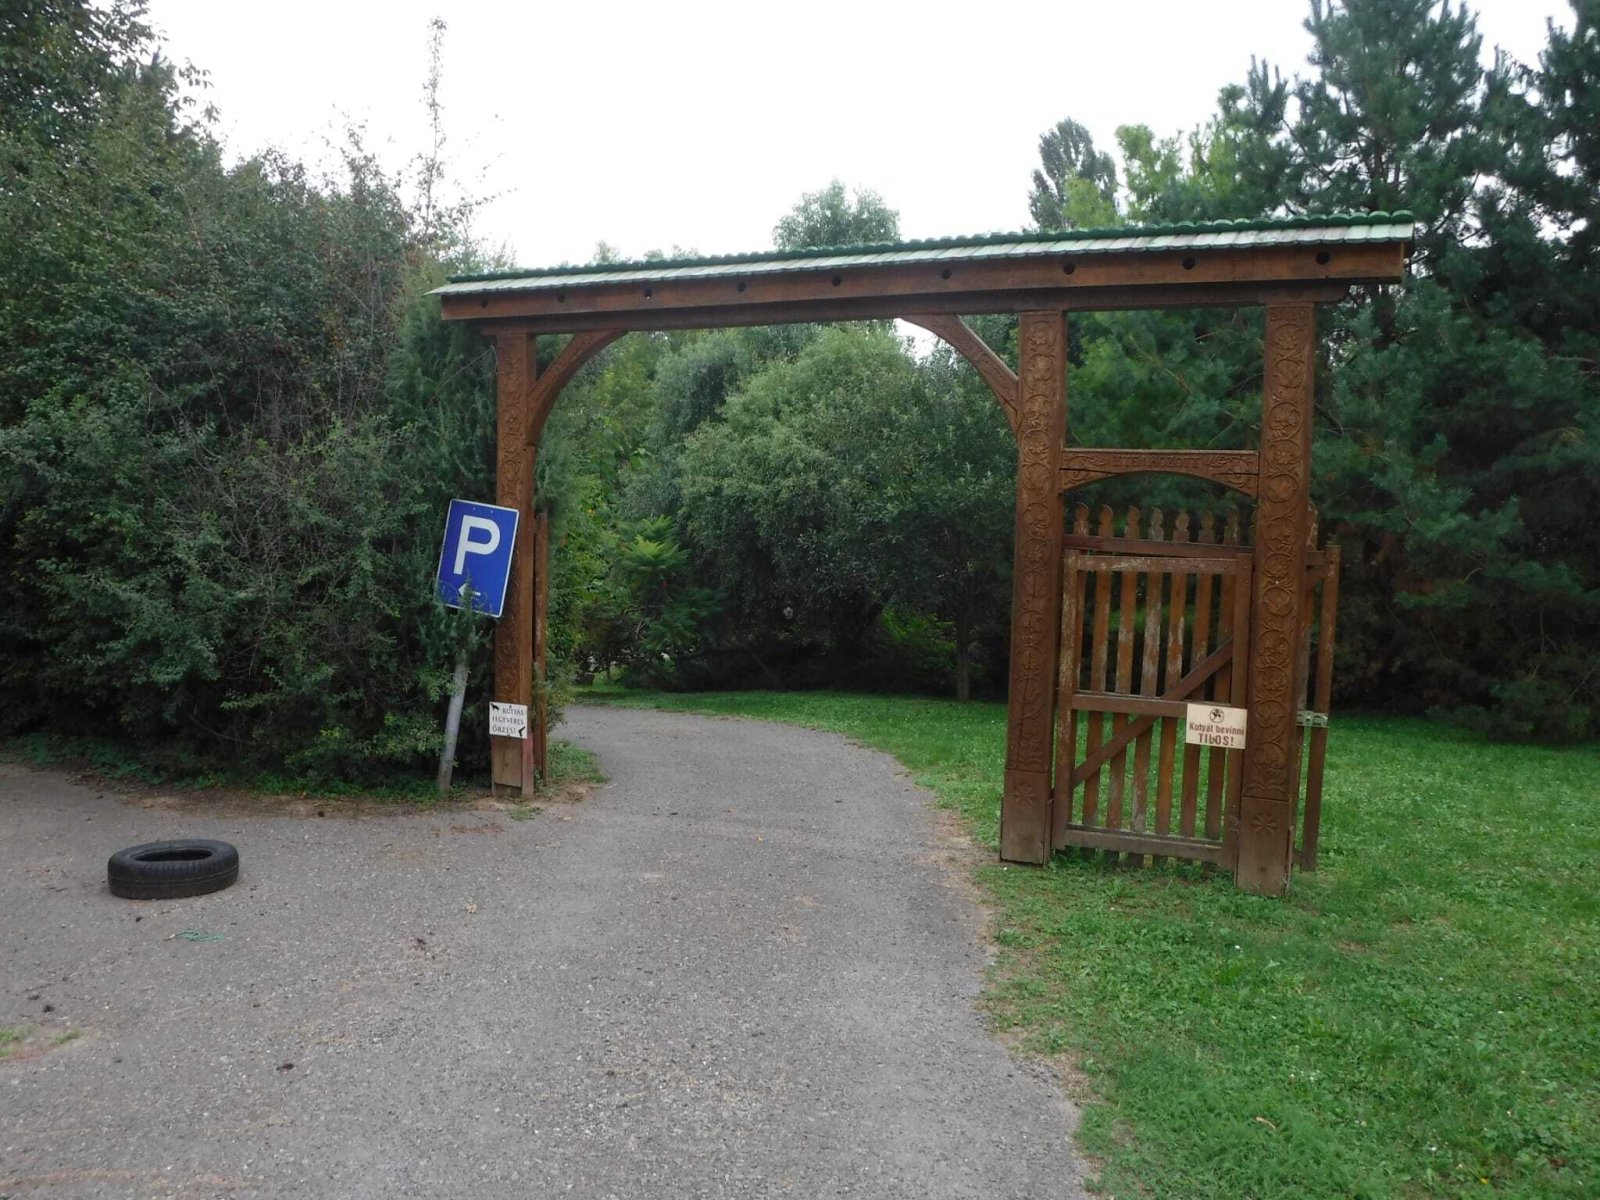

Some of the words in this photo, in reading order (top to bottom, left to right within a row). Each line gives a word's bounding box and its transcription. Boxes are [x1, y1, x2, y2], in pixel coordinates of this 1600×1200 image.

[453, 514, 501, 575] P
[1215, 725, 1245, 736] bevinni
[1198, 733, 1234, 746] TILOS!
